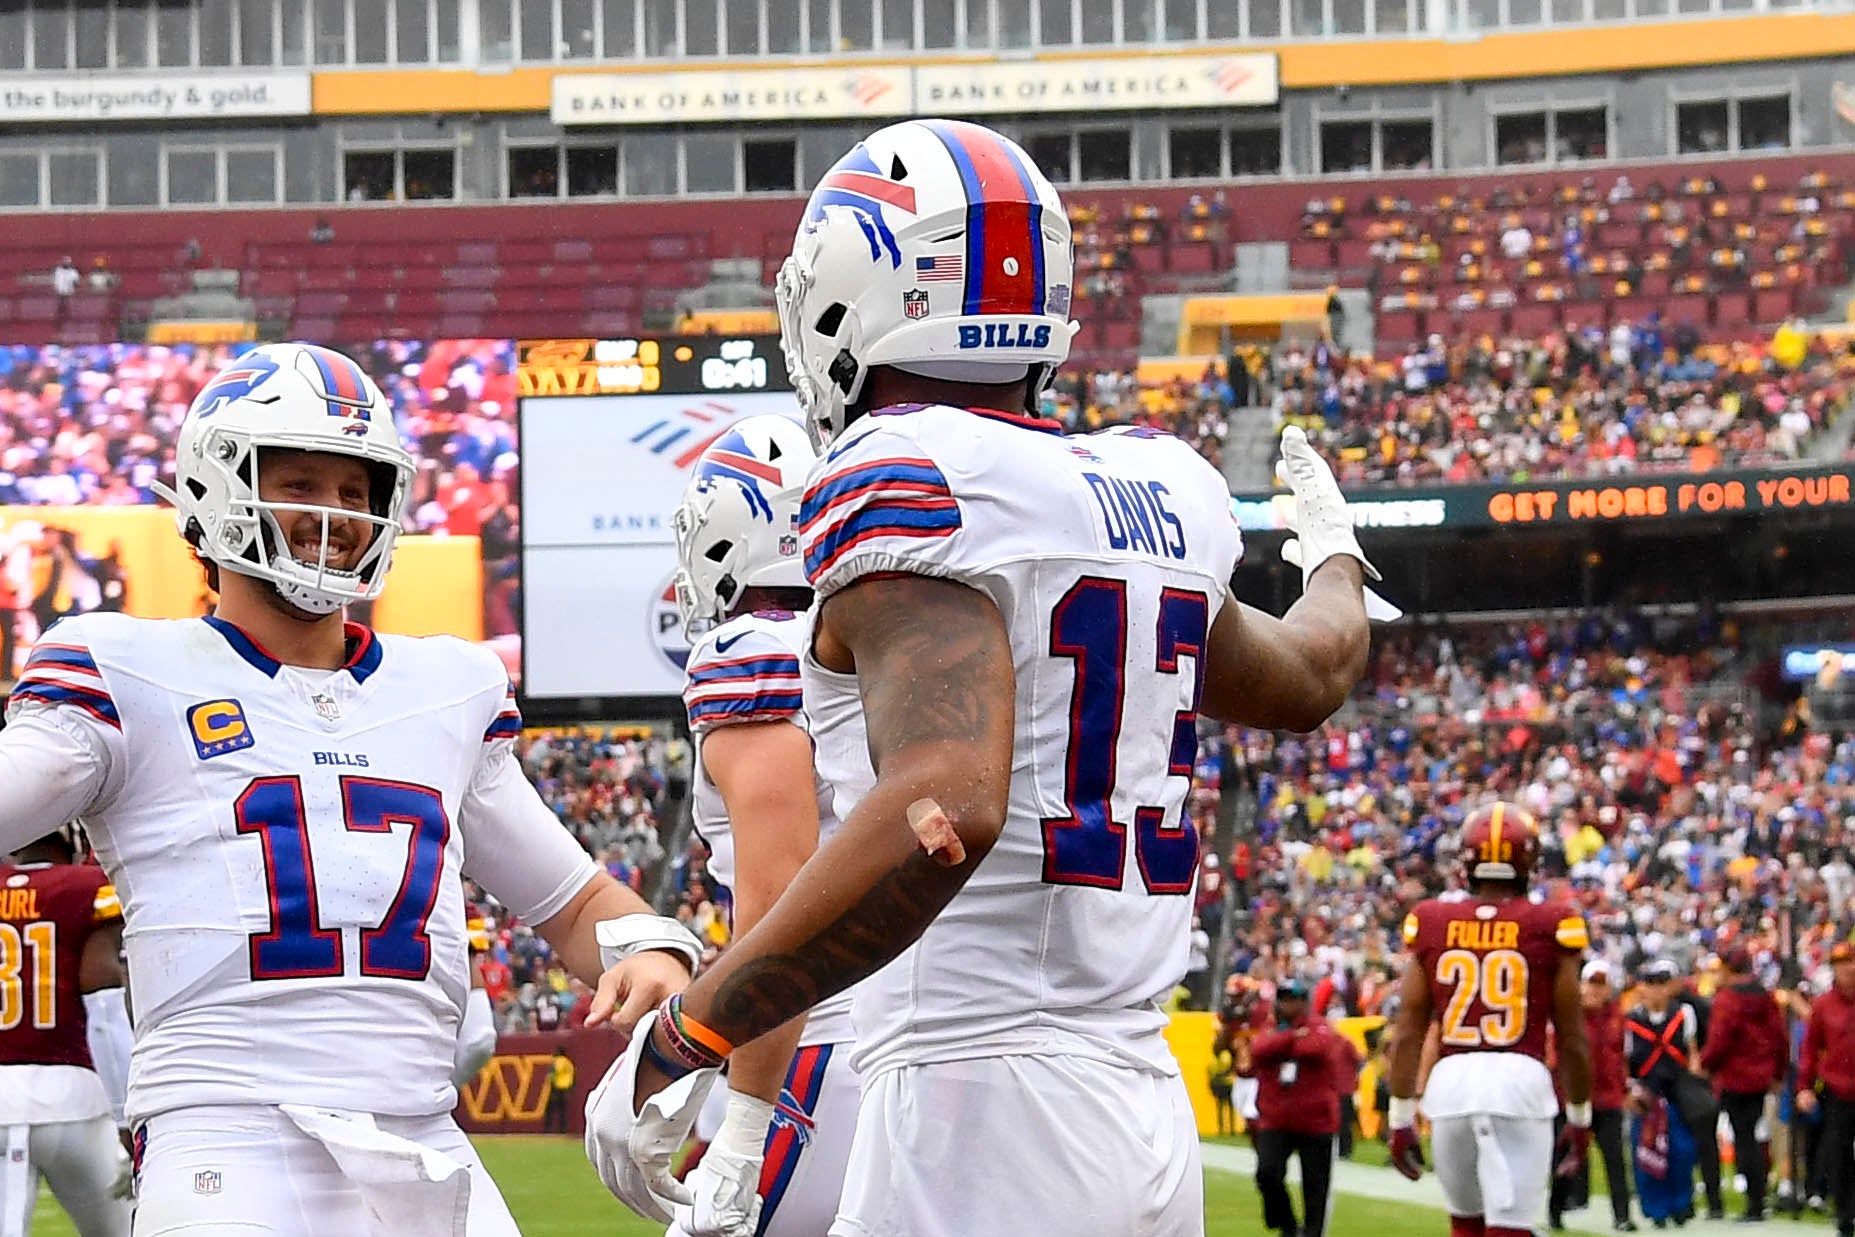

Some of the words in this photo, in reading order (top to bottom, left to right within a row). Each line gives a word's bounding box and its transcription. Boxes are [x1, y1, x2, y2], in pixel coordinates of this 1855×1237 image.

[5, 86, 44, 107] the
[53, 84, 176, 110] burgundy
[186, 86, 201, 104] &
[571, 95, 645, 112] BANK
[658, 94, 689, 110] OF
[700, 89, 829, 107] AMERICA
[930, 83, 1005, 101] BANK
[1061, 77, 1191, 95] AMERICA
[958, 324, 1051, 349] BILLS
[1489, 493, 1558, 523] GET
[1568, 486, 1667, 519] MORE
[1678, 480, 1746, 512] FOR
[1757, 474, 1850, 506] YOUR
[592, 515, 662, 531] BANK
[1081, 472, 1187, 560] DAVIS
[191, 701, 246, 744] C
[1040, 575, 1210, 896] 13
[312, 752, 370, 768] BILLS
[234, 775, 450, 981] 17
[1447, 920, 1520, 949] FULLER
[1436, 949, 1529, 1046] 29
